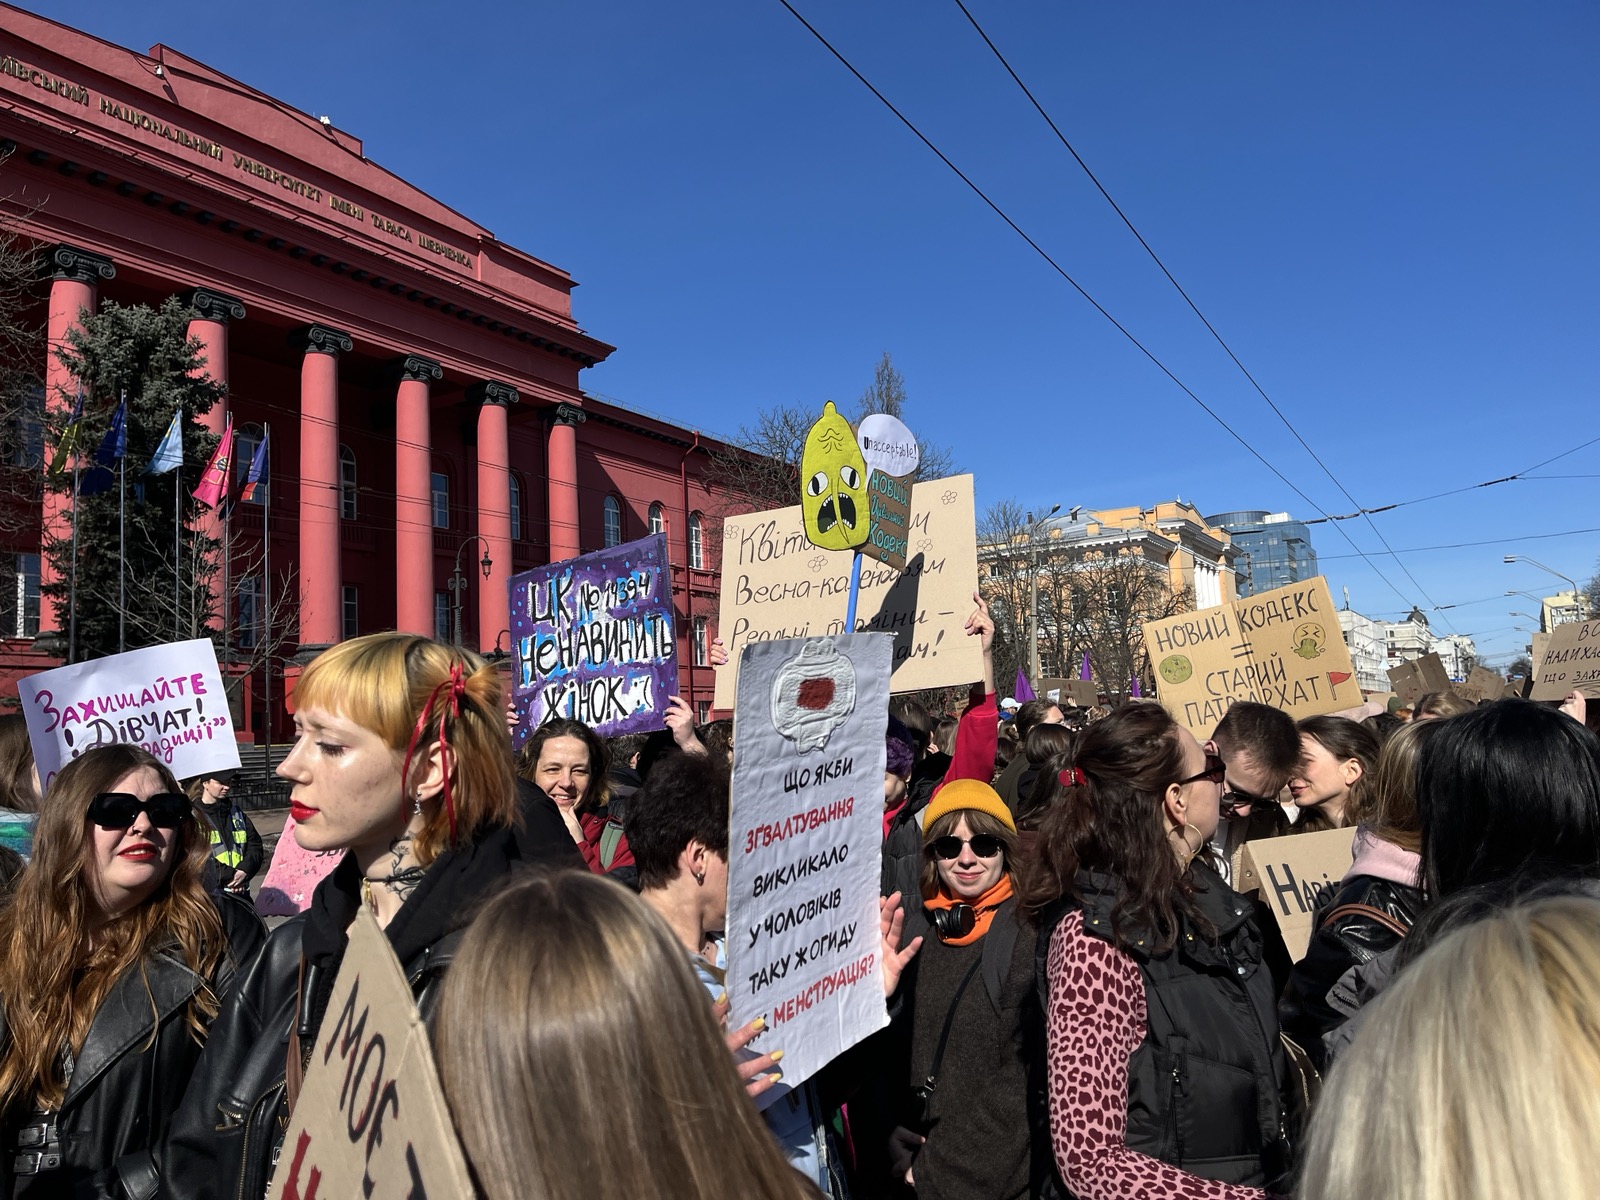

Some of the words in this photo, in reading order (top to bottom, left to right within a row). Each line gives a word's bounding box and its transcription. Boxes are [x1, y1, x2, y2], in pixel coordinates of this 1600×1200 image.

[99, 96, 223, 162] НАЦІОНАЛЬНИЙ
[232, 153, 322, 203] УНІВЕРСИТЕТ
[329, 195, 363, 222] ІМЕНІ
[371, 213, 413, 243] ТАРАСА
[418, 234, 473, 270] ШЕВЧЕНКА
[864, 436, 917, 460] Unacceptable!
[871, 471, 908, 507] НОВИЙ
[869, 519, 908, 561] Кодекс
[531, 576, 573, 627] ЦК
[736, 557, 946, 606] Весна-каендарям
[826, 608, 929, 635] трміни
[1155, 610, 1231, 652] НОВИЙ
[1236, 588, 1319, 633] КОДЕКС
[1206, 652, 1287, 696] СТАРИЙ
[1543, 672, 1566, 684] ЩО
[1184, 675, 1320, 727] ПАТРАРХАТ
[784, 768, 810, 794] ЩО
[814, 758, 853, 786] ЯКБИ
[745, 797, 854, 854] ЗҐВАЛТУВАННЯ
[752, 844, 848, 898] ВИКЛИКАЛО
[749, 924, 761, 949] У
[764, 888, 841, 938] ЧОЛОВІКІВ
[749, 954, 791, 995] ТАКУ
[794, 946, 807, 971] Ж
[810, 922, 857, 961] ОГИДУ
[773, 953, 875, 1028] МЕНСТРУАЦІЯ?
